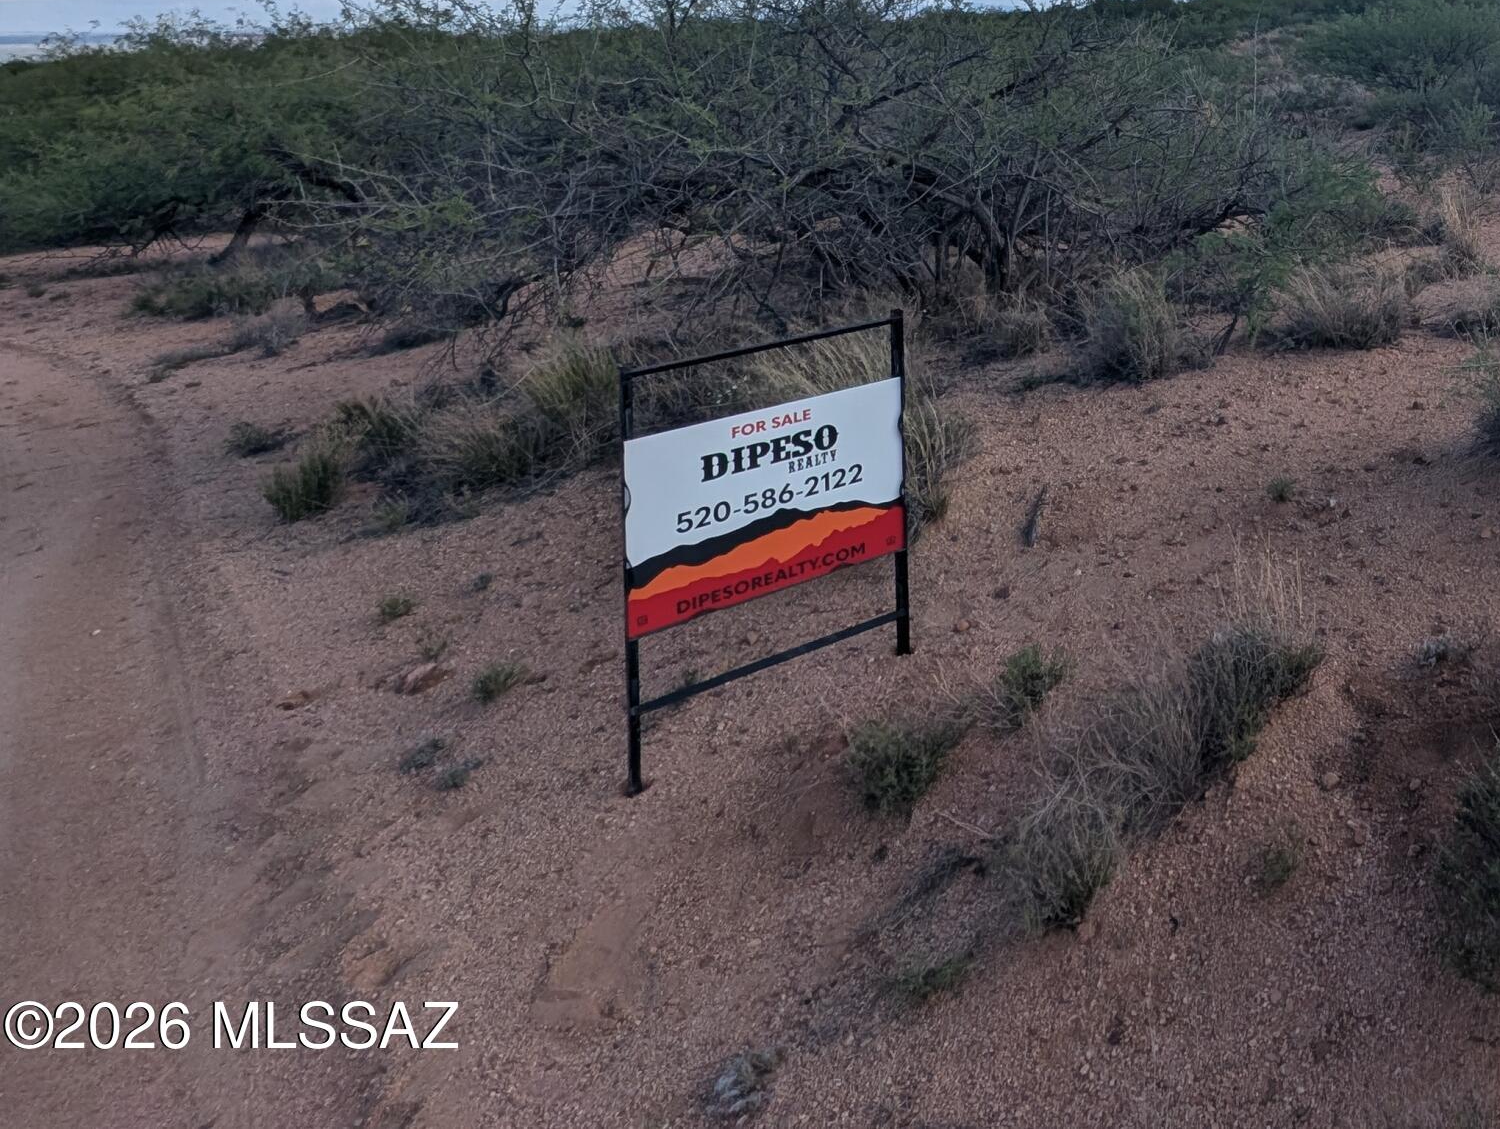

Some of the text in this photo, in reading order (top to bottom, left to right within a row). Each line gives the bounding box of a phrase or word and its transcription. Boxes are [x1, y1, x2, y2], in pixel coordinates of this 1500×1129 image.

[700, 424, 838, 482] DIPESO
[731, 409, 812, 439] FOR SALE
[788, 449, 838, 474] REALTY
[676, 463, 863, 534] 520-586-2122
[676, 542, 866, 615] DIPESOREALTY.COM
